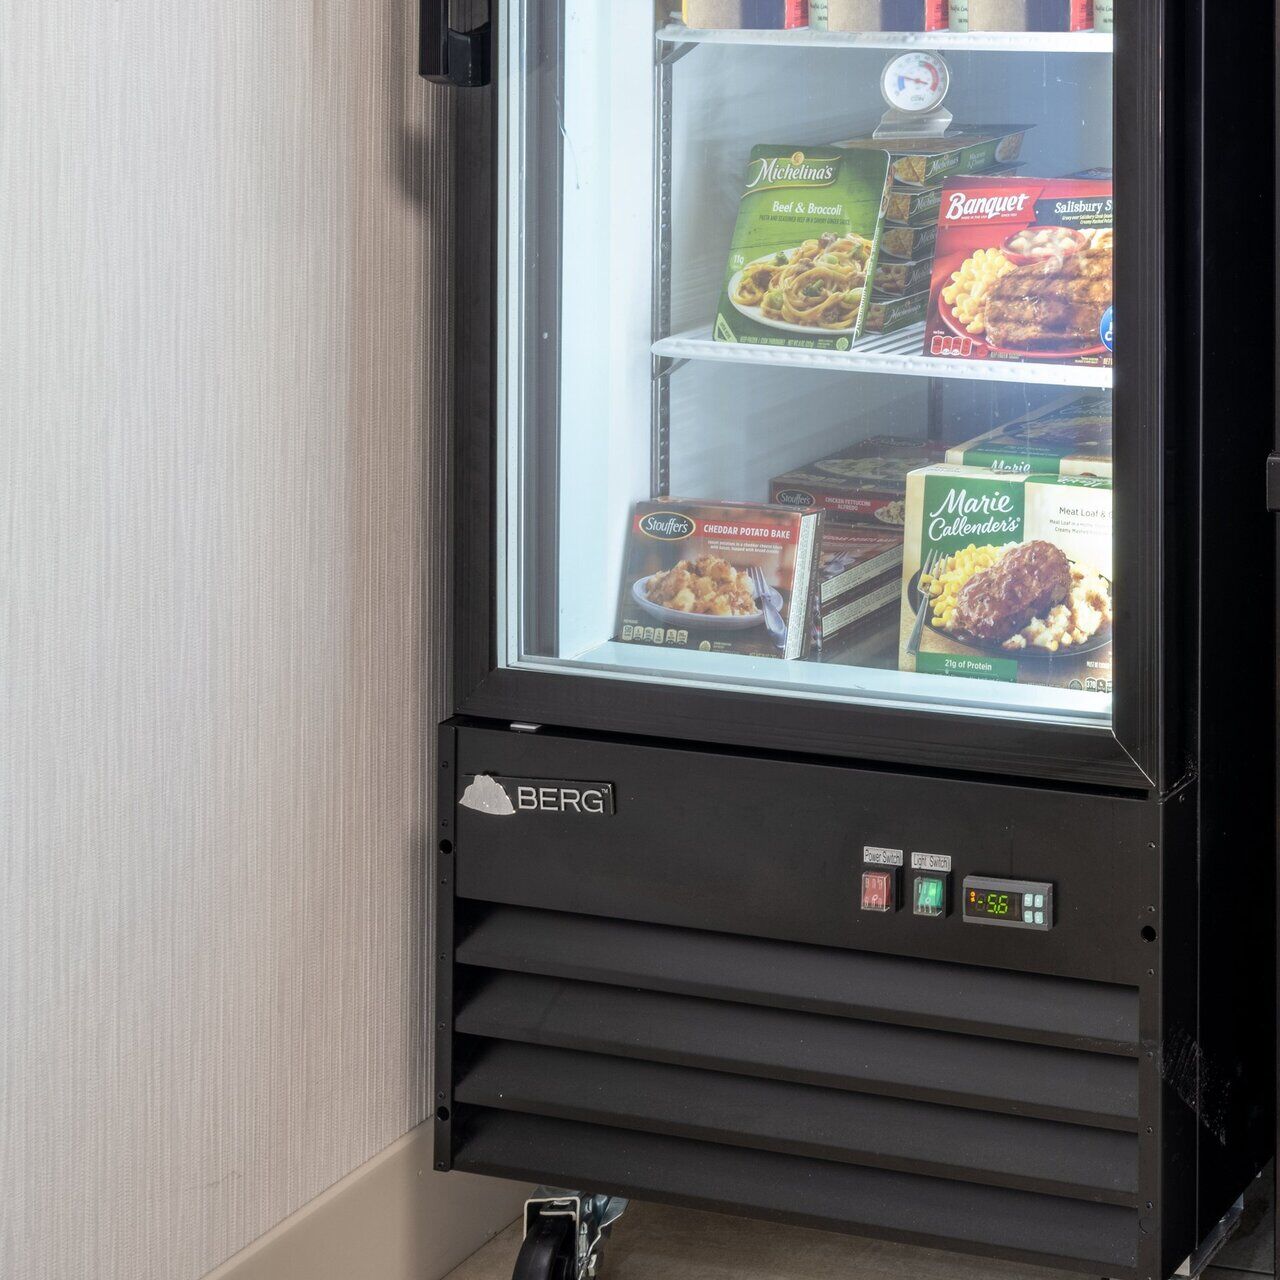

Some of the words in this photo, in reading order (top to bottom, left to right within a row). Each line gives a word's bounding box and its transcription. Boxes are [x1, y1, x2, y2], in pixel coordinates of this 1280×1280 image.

[746, 158, 833, 188] Michelina's
[773, 200, 793, 213] Beef
[795, 202, 804, 213] &
[808, 202, 842, 215] Broccoli
[946, 192, 1030, 220] Banquet
[1054, 200, 1102, 214] Salisbury
[930, 488, 1014, 517] Marie
[646, 517, 689, 536] Stouffer's
[703, 525, 738, 535] CHEDDAR
[740, 527, 769, 537] POTATO
[771, 530, 790, 539] BAKE
[929, 516, 1018, 541] Callender's
[958, 660, 965, 669] of
[967, 662, 992, 671] Protein
[517, 786, 605, 814] BERG
[865, 849, 881, 862] Power
[882, 851, 901, 864] Switch
[930, 858, 948, 869] Switch
